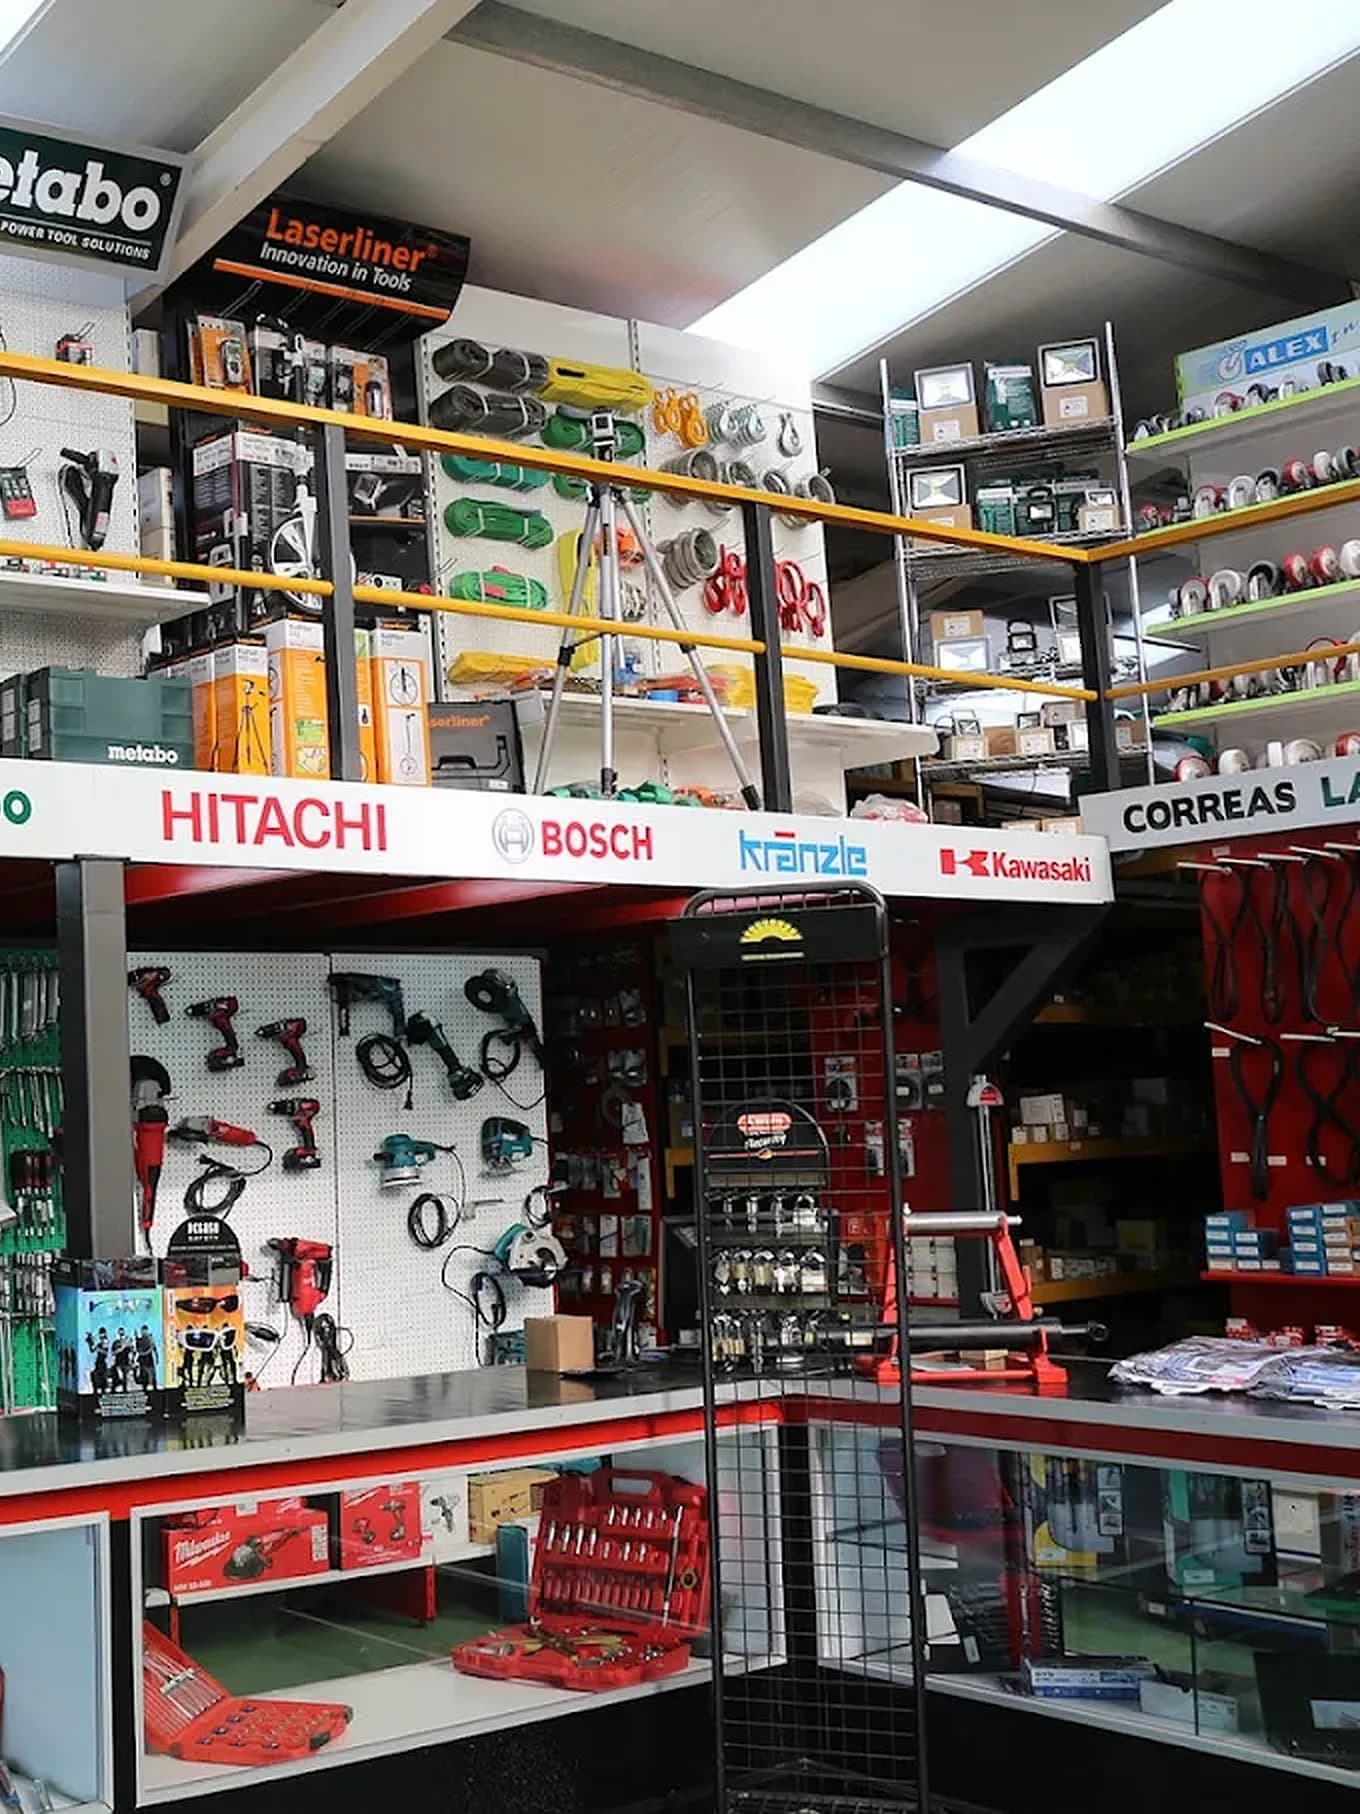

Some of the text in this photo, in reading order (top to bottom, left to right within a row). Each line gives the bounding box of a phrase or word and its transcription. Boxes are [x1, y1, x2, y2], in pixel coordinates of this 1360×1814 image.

[0, 219, 45, 240] POWER
[47, 229, 78, 247] TOOL
[82, 236, 151, 261] SOLUTIONS
[259, 241, 413, 292] Innovation in Tools
[1249, 333, 1324, 369] ALEX
[107, 744, 179, 763] metabo
[161, 789, 387, 850] HITACHI
[1123, 782, 1296, 834] CORREAS
[542, 820, 653, 861] BOSCH
[992, 851, 1091, 882] Kawasaki
